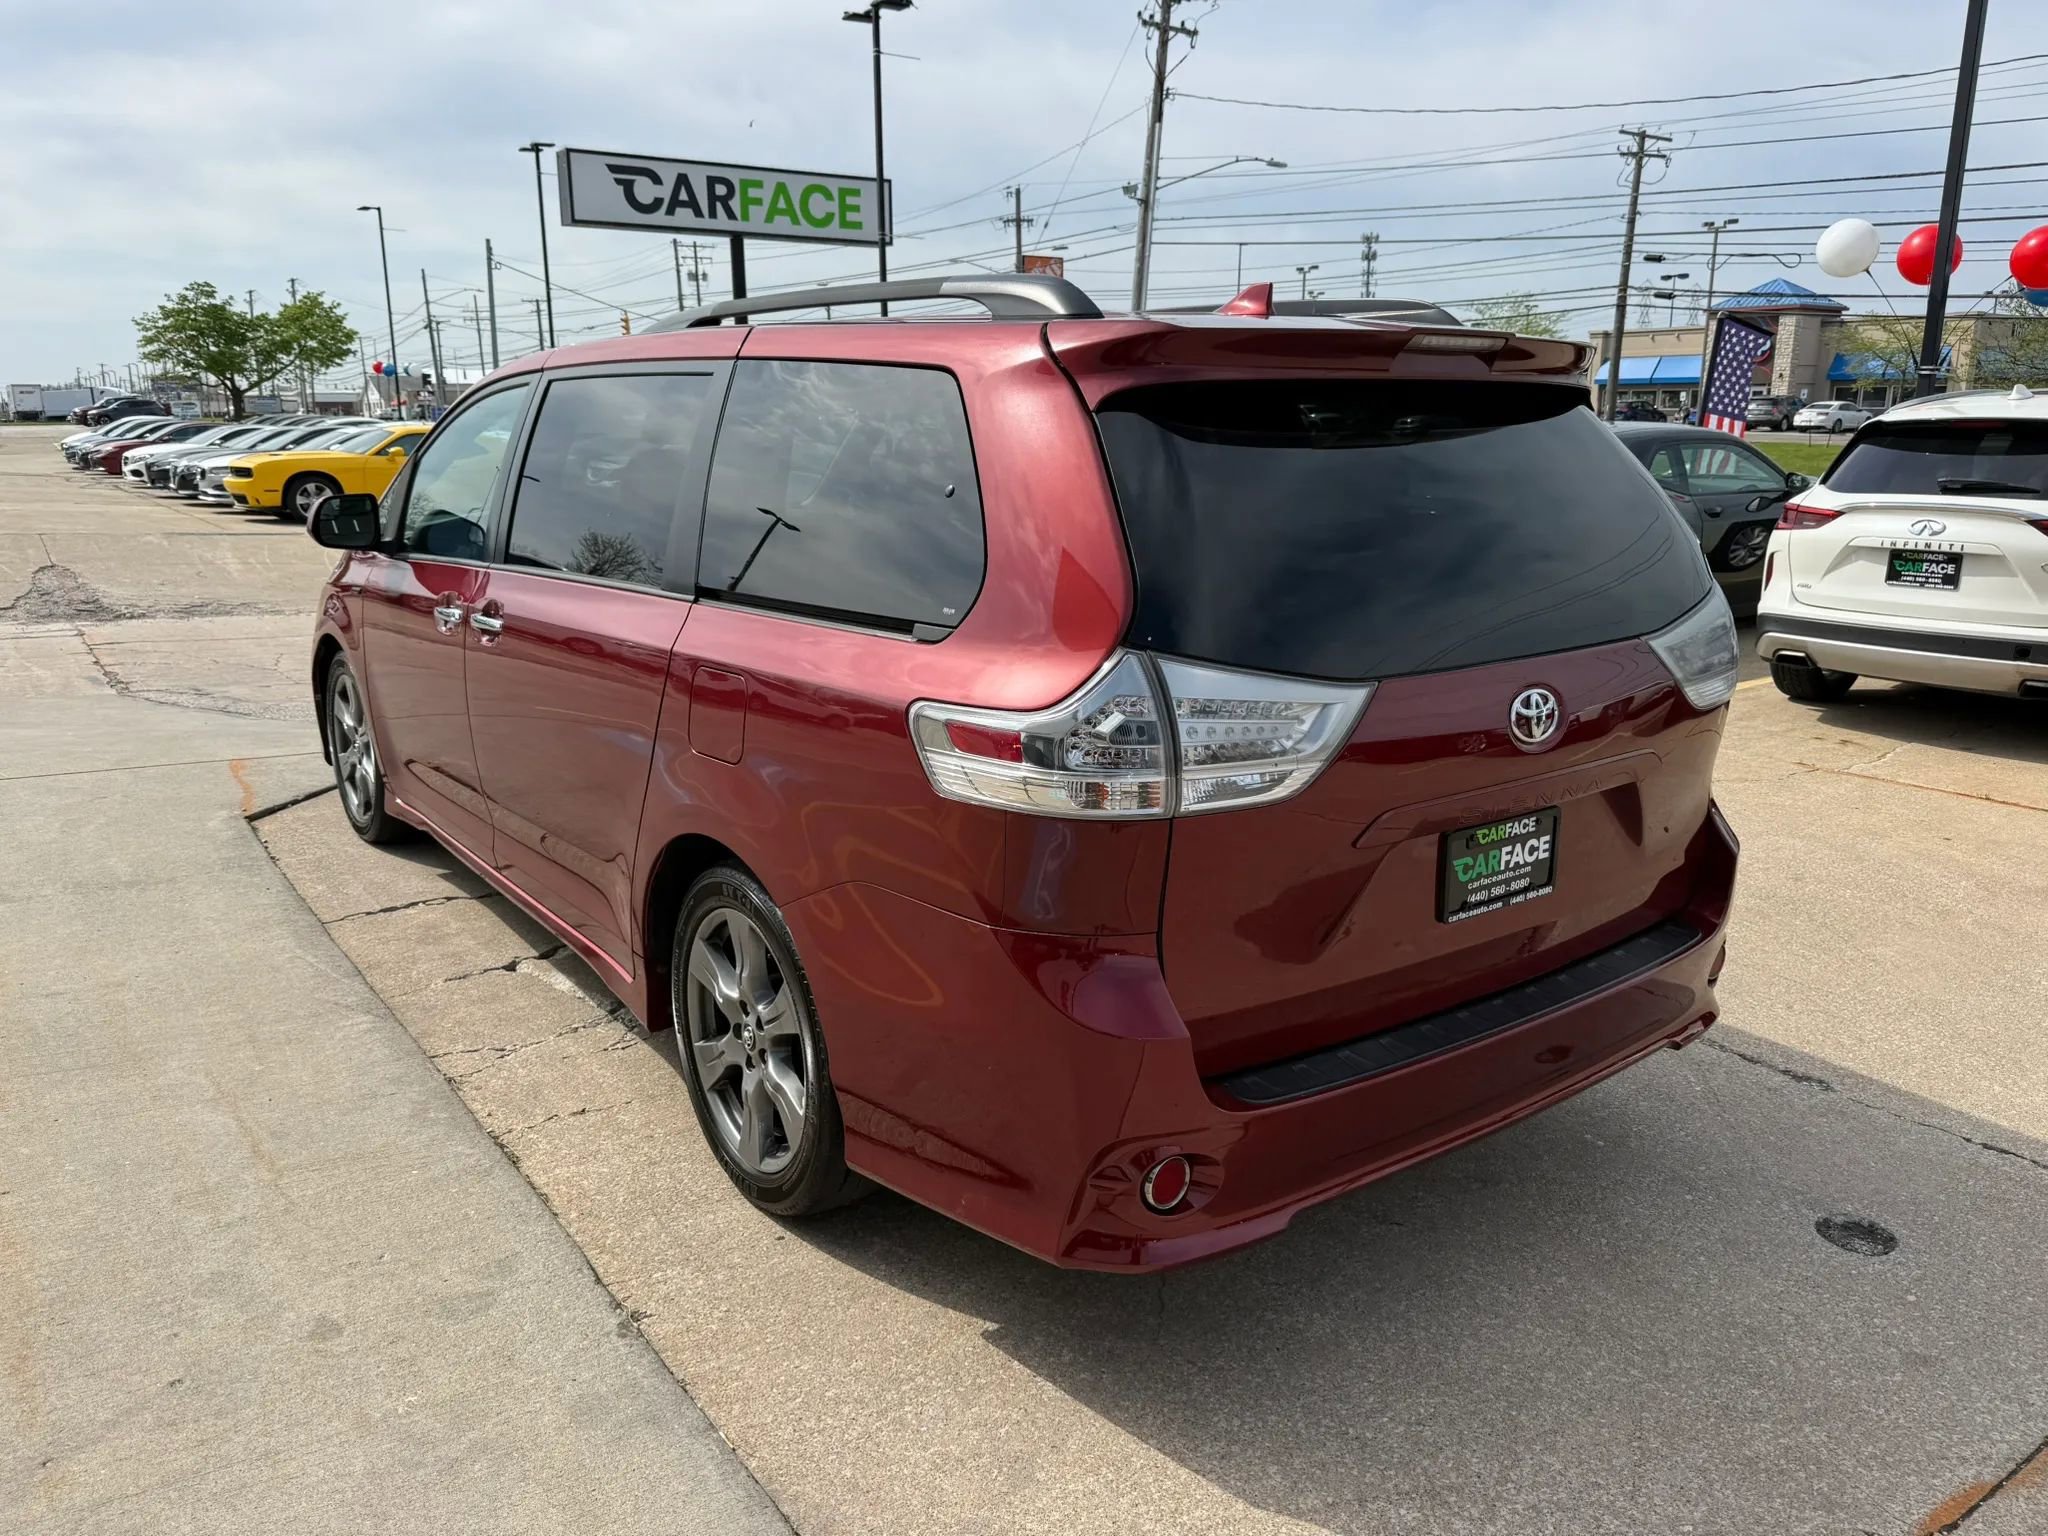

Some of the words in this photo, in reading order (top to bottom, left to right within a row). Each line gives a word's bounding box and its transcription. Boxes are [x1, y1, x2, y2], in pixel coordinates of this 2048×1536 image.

[605, 163, 864, 230] CARFACE
[1881, 540, 1964, 551] INFINITI
[1905, 551, 1944, 561] CARFACE
[1893, 560, 1956, 574] CARFACE
[1476, 817, 1537, 844] CARFACE
[1453, 835, 1551, 882] CARFACE
[1468, 865, 1532, 889] carfaceauto.com
[1467, 889, 1489, 903] (440)
[1448, 901, 1503, 923] carfaceauto.com
